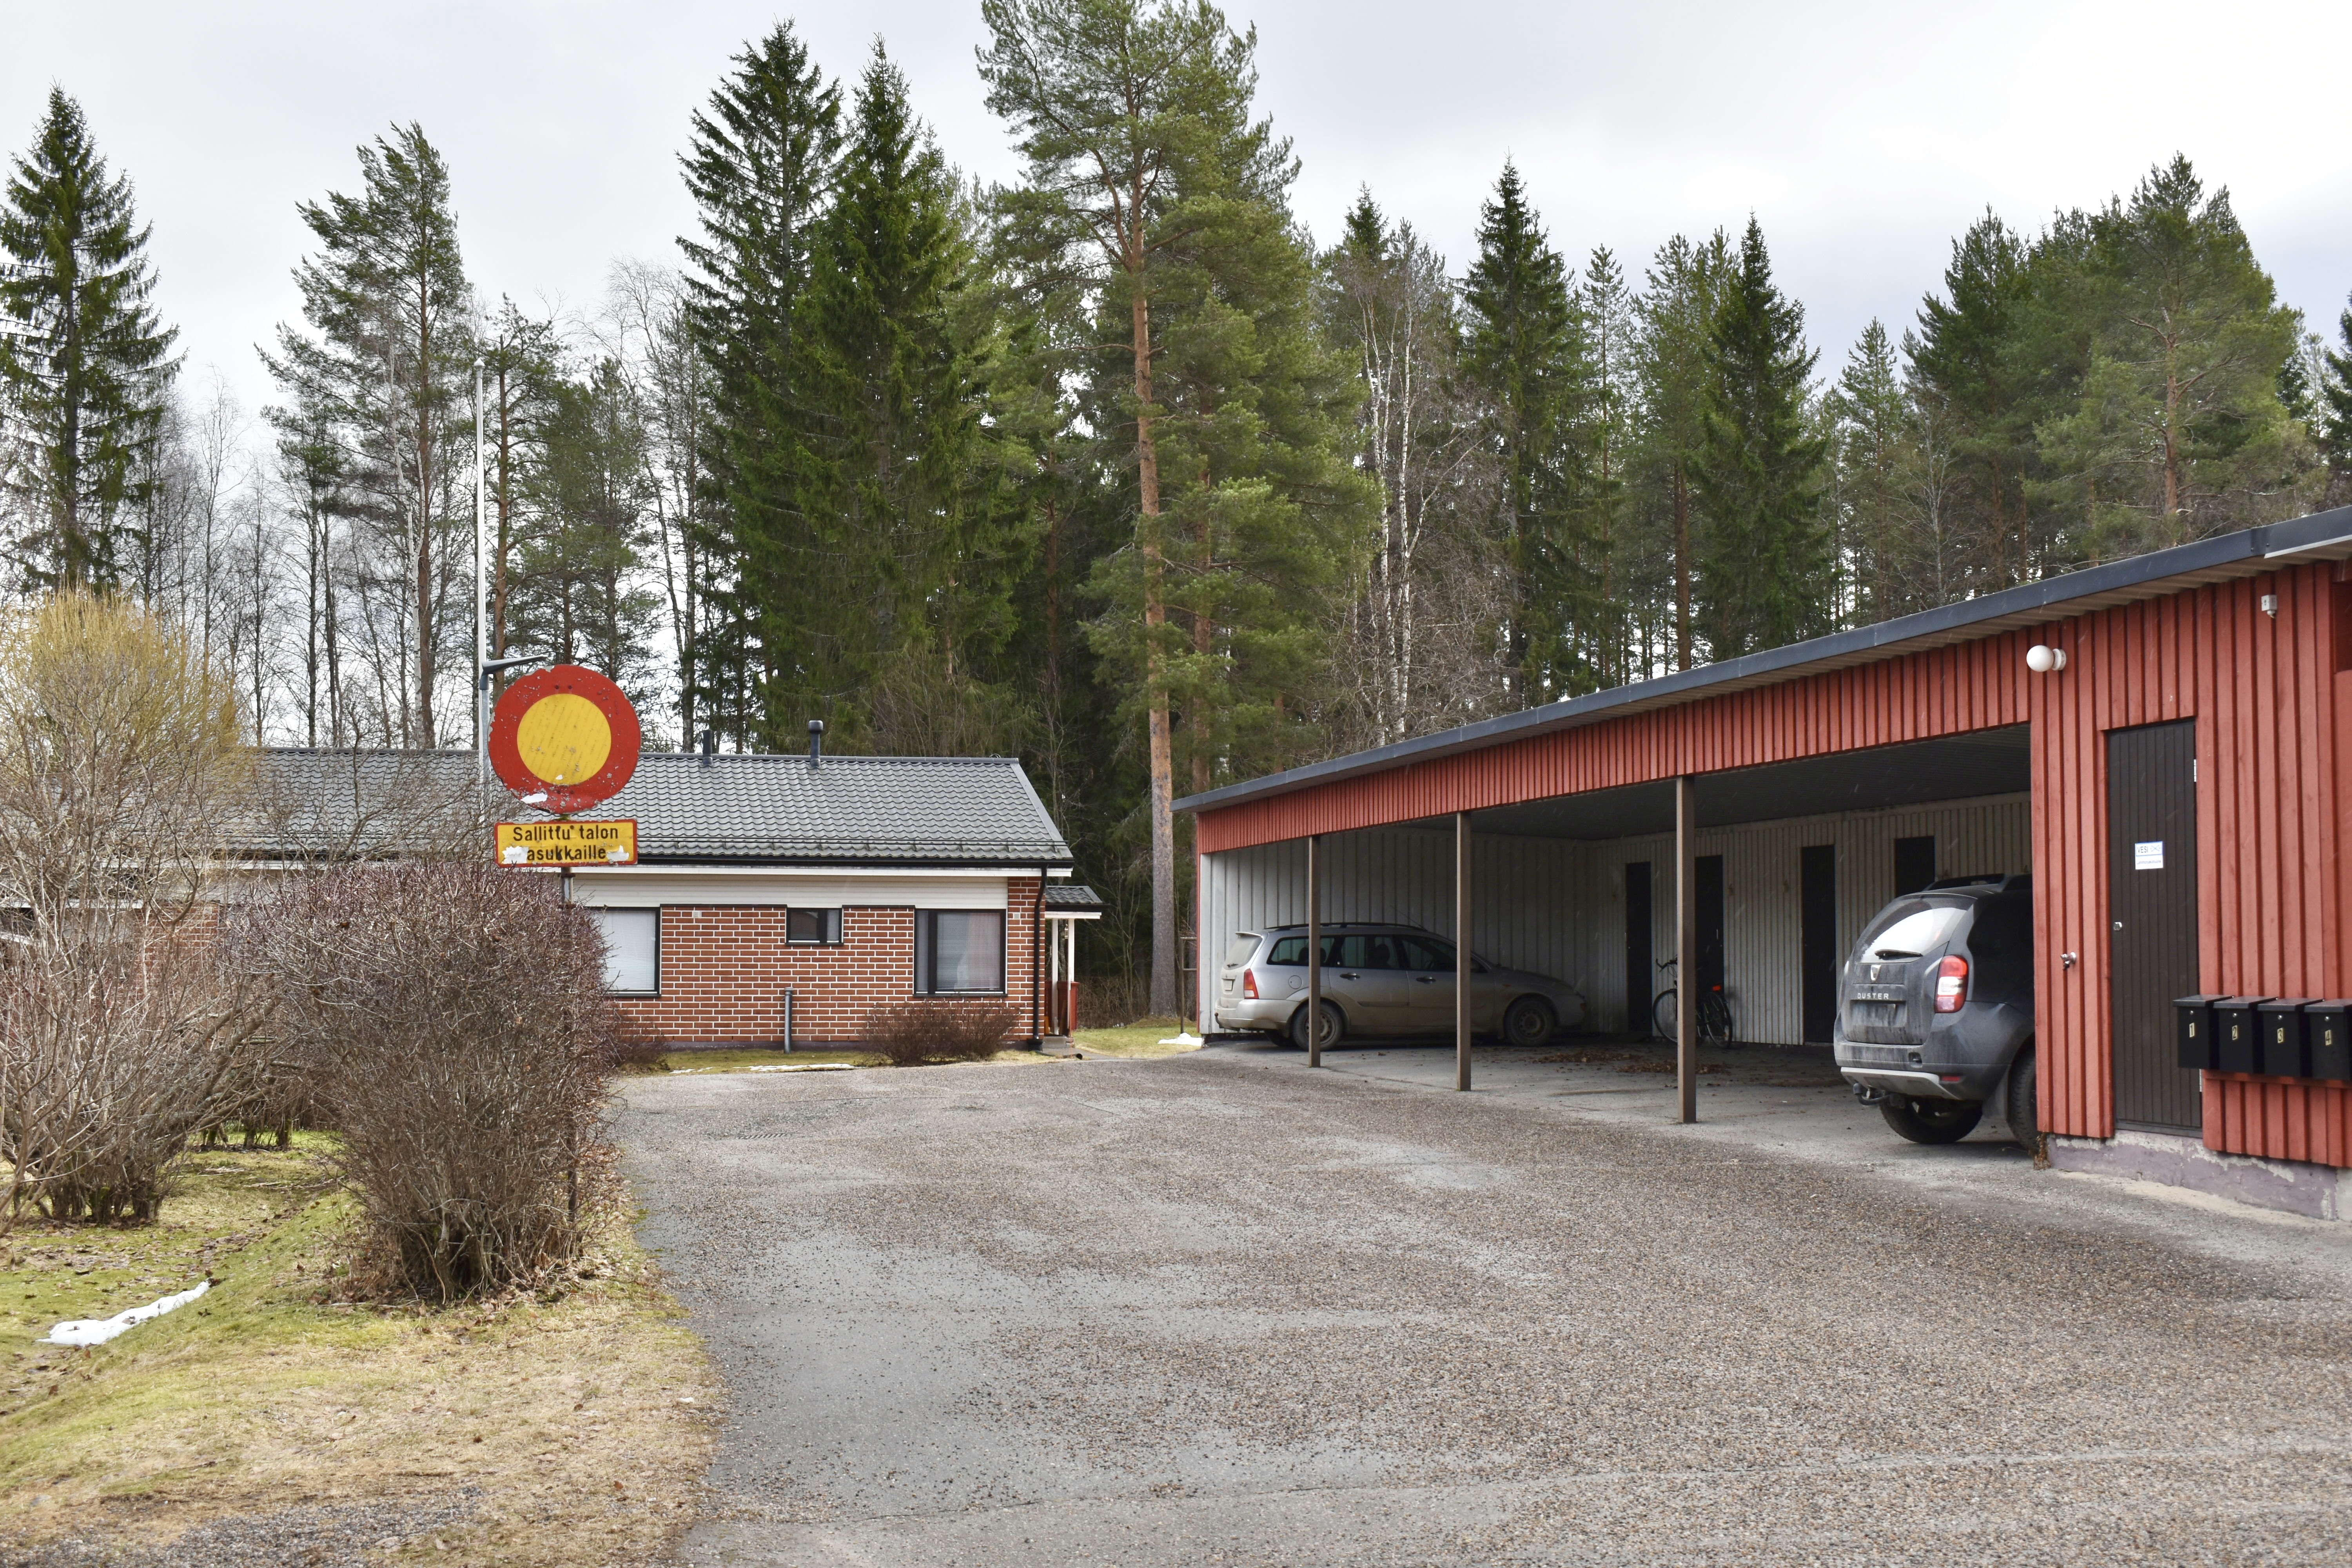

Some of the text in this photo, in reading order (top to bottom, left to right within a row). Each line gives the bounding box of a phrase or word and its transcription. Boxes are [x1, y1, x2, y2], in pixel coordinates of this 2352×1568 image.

[513, 825, 618, 841] Sallittu talon
[527, 845, 606, 860] asukkaille
[2232, 1026, 2237, 1039] 2
[2278, 1029, 2282, 1042] 3
[2326, 1030, 2330, 1044] 4
